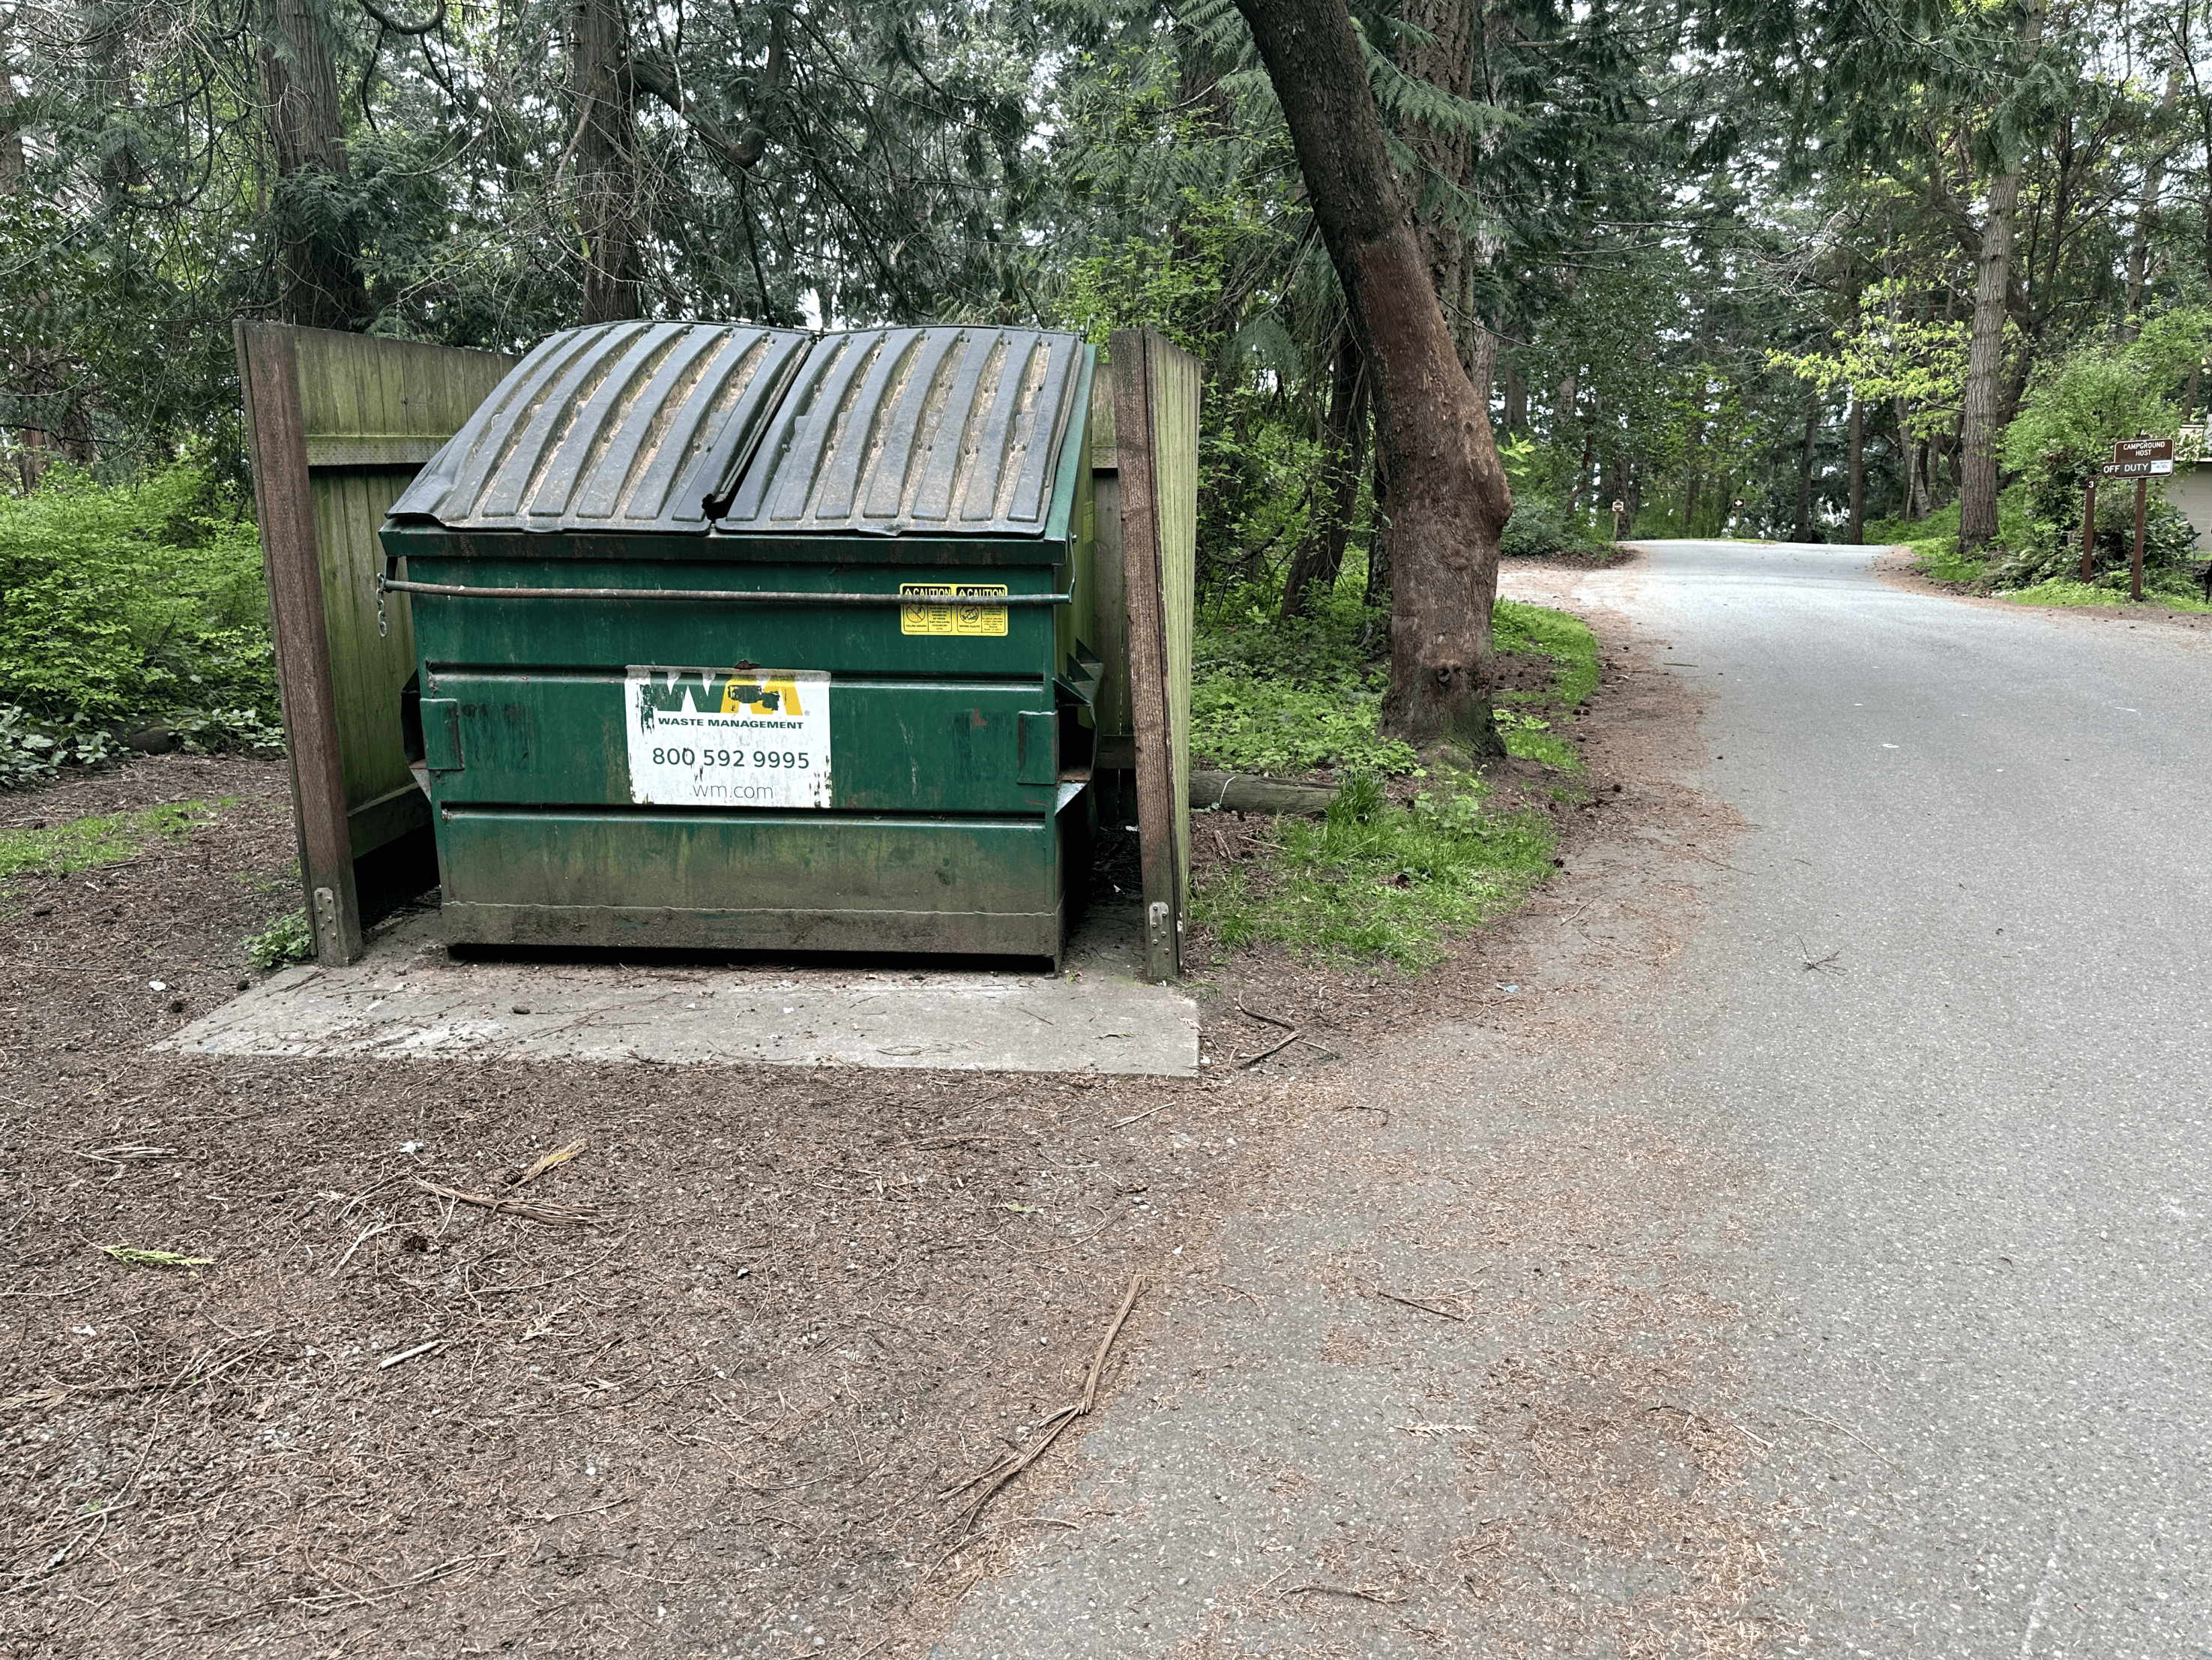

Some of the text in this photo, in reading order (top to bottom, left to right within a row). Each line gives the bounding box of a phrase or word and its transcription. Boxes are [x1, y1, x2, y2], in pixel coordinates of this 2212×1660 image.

[2123, 441, 2166, 451] CAMPGROUND
[2103, 465, 2121, 473] OFF
[2124, 463, 2149, 472] DUTY
[913, 588, 951, 596] CAUTION
[967, 589, 1005, 597] CAUTION
[658, 718, 804, 730] WASTE MANAGEMENT
[652, 748, 810, 769] 800 592 9995
[693, 785, 774, 799] wm.com
